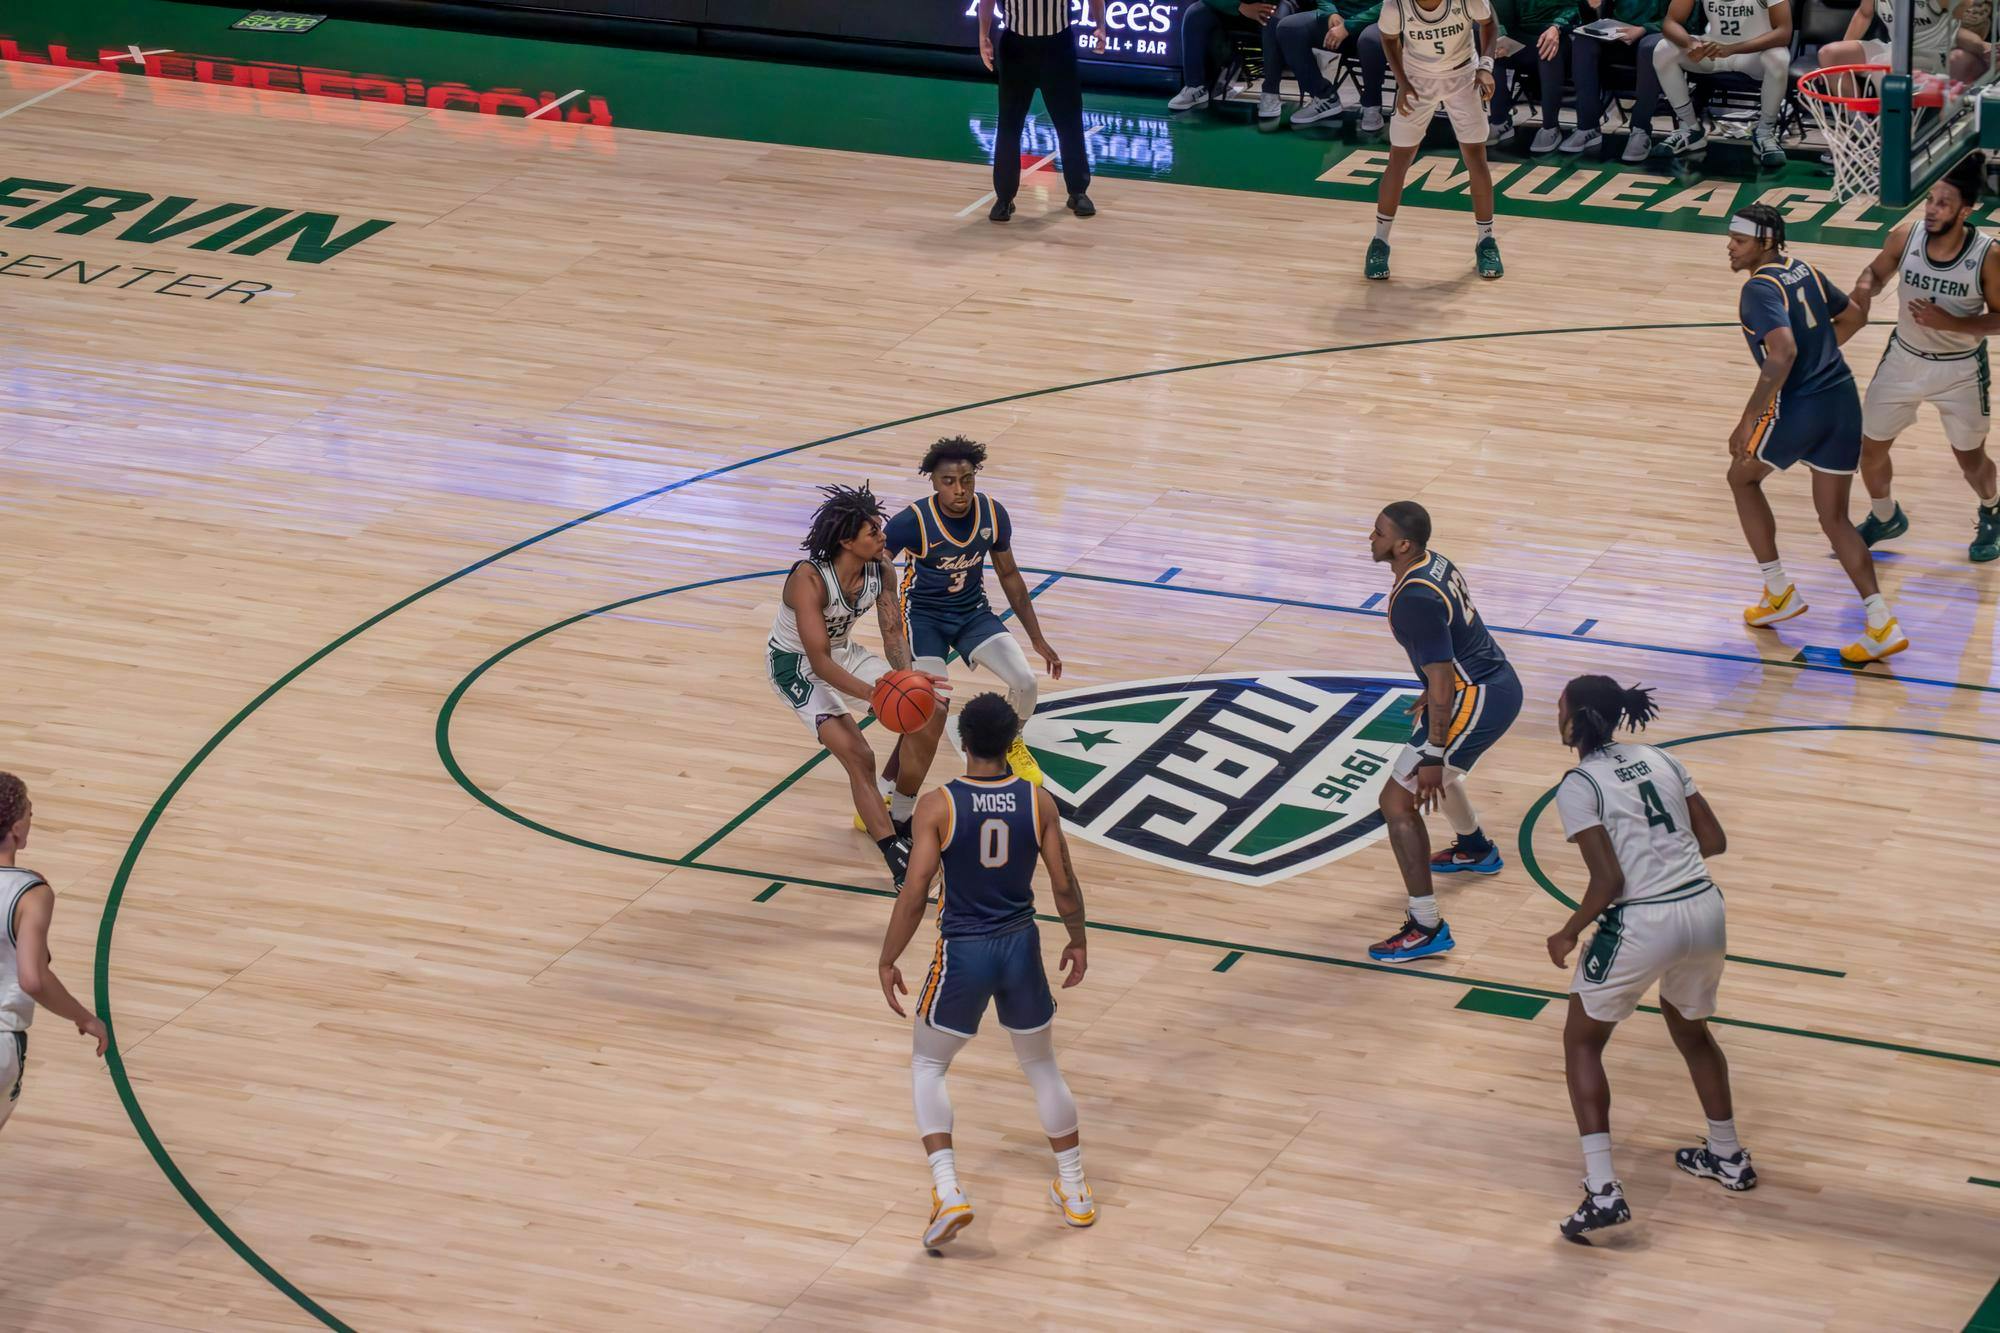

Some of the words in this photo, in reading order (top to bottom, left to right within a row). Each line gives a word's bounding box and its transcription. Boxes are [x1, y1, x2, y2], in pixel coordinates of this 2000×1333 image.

[1409, 22, 1465, 41] EASTERN
[1720, 20, 1742, 36] 22
[1079, 34, 1121, 51] GRLL
[1136, 39, 1167, 54] BAR
[1433, 41, 1446, 55] 5
[1315, 150, 2000, 242] EMUEAGL
[0, 250, 273, 304] ENTER
[1904, 269, 1970, 297] EASTERN
[1796, 286, 1818, 329] 1
[935, 551, 983, 571] Toledo
[947, 570, 968, 593] 3
[1312, 749, 1389, 804] 1946
[1614, 760, 1652, 783] GEETER
[971, 792, 1017, 812] MOSS
[1638, 779, 1678, 834] 4
[980, 818, 1010, 868] 0
